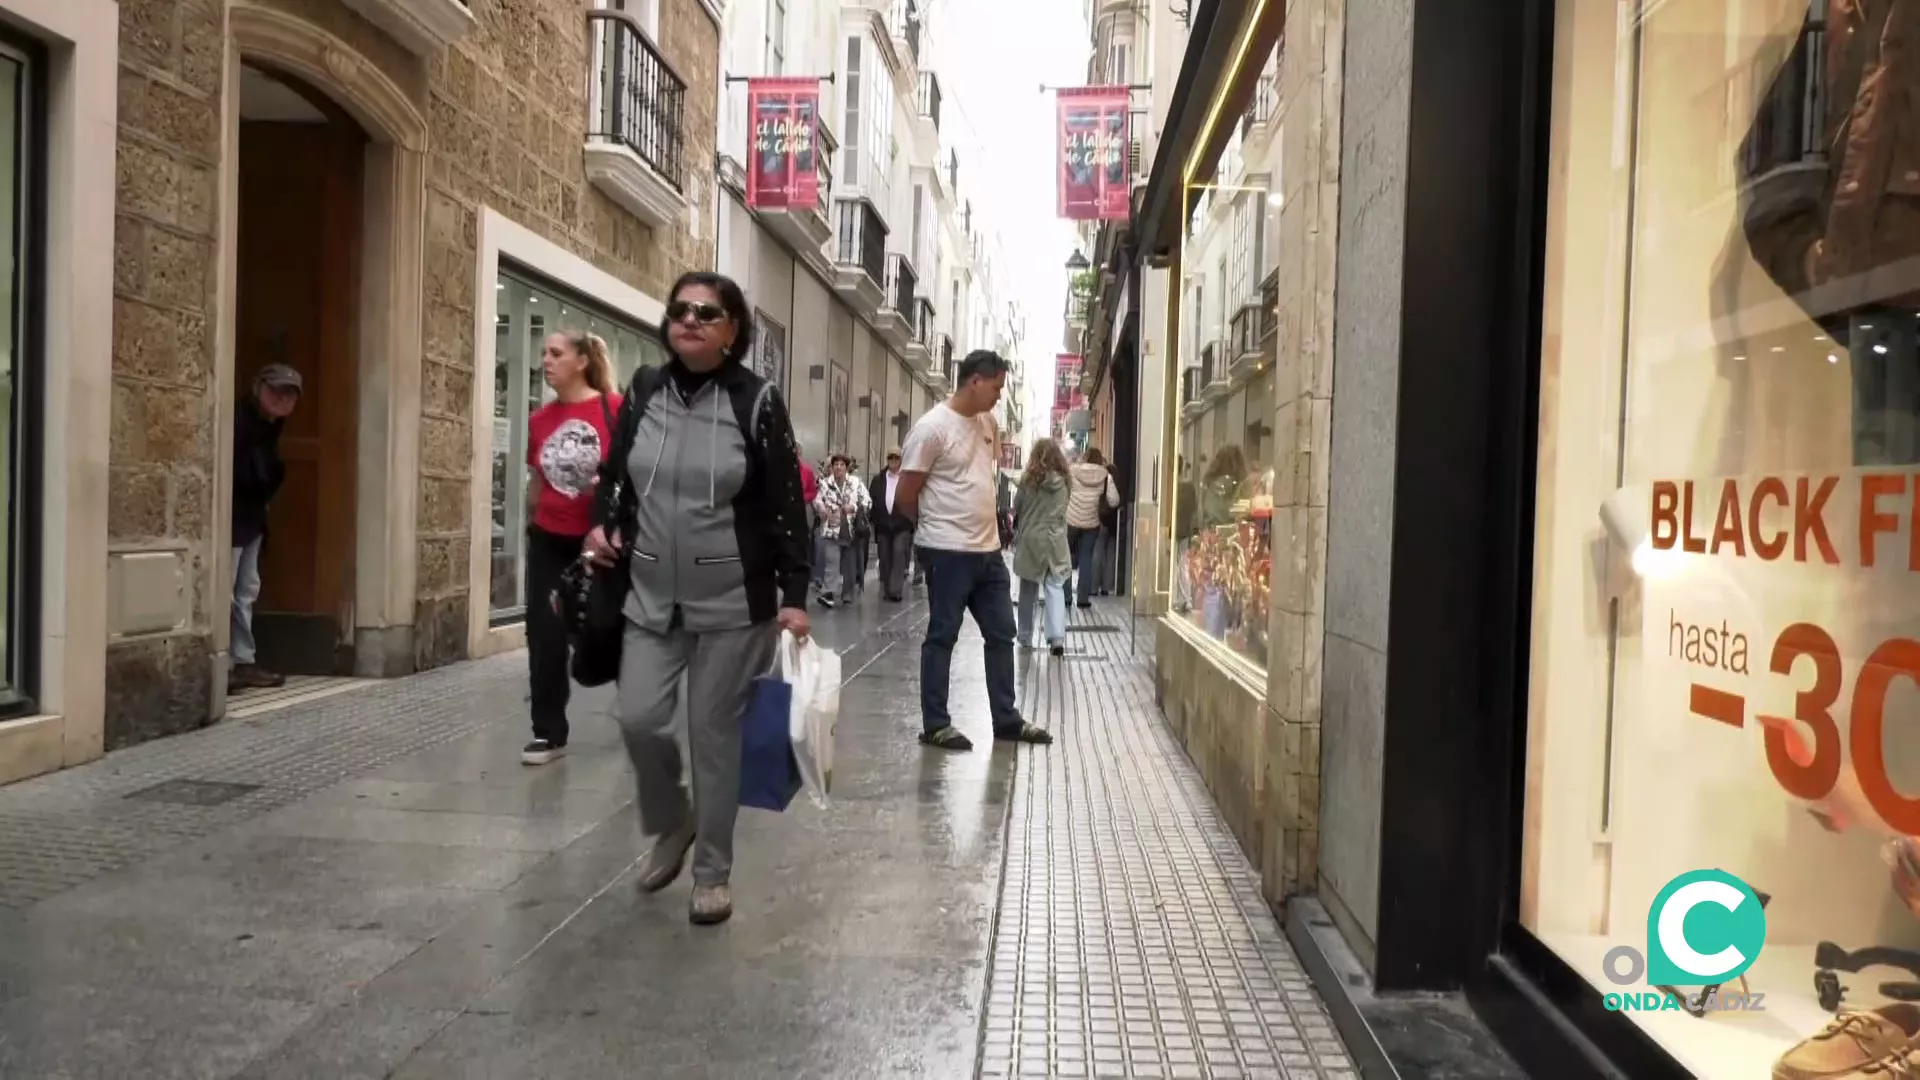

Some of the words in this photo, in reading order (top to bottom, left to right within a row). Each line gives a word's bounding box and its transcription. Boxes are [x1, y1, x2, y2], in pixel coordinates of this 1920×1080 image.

[754, 135, 771, 152] de
[1650, 476, 1841, 567] BLACK
[1859, 474, 1920, 571] F
[1668, 607, 1749, 675] hasta
